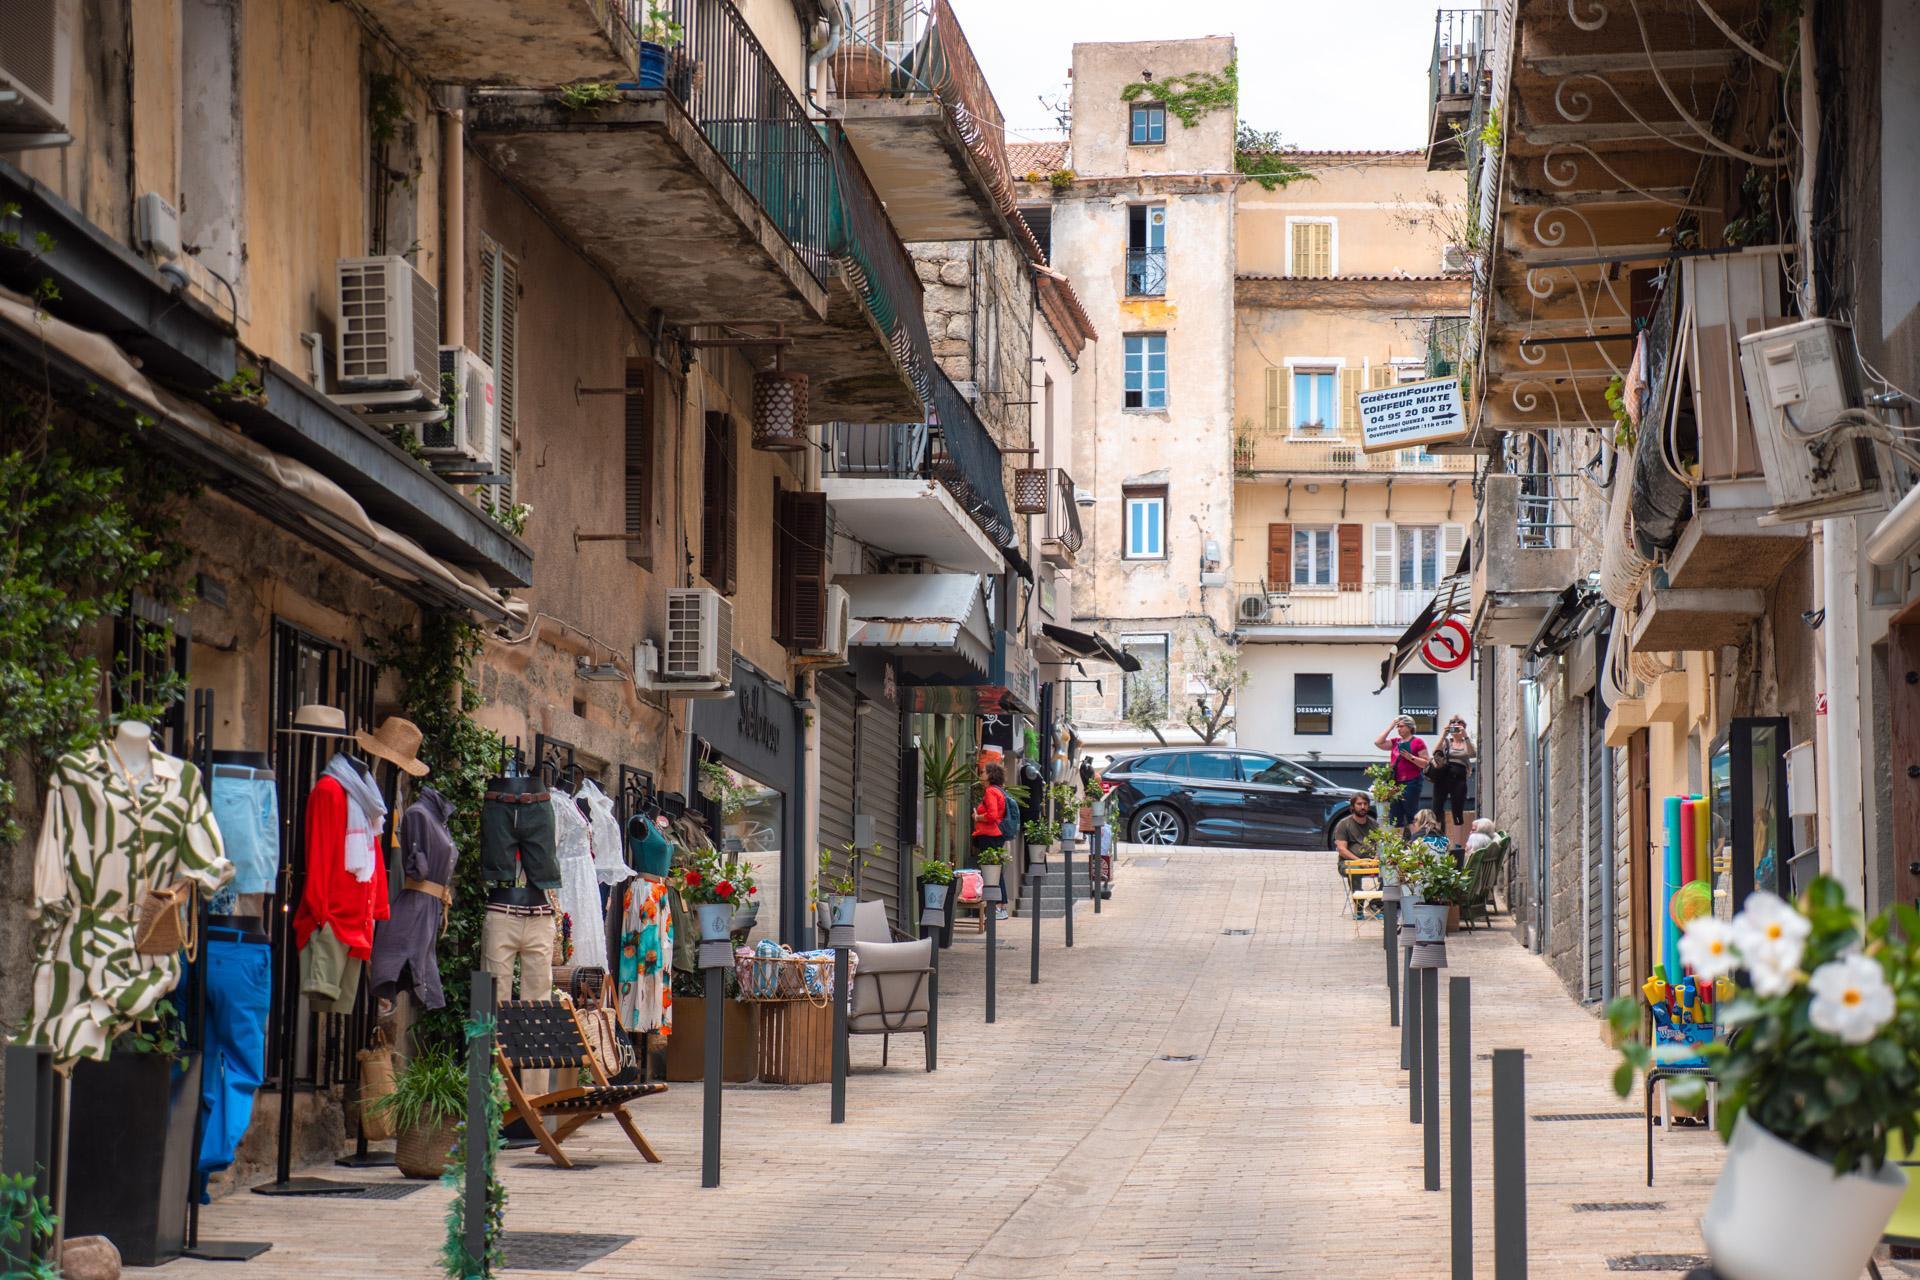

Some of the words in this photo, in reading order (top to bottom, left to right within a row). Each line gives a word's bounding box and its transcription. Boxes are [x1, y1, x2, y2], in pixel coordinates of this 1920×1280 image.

[1363, 399, 1413, 415] COIFFEUR
[1416, 393, 1450, 405] MIXTE
[1370, 416, 1385, 424] 04
[1387, 412, 1401, 421] 95
[1405, 408, 1418, 418] 20
[1421, 405, 1435, 414] 80
[1438, 403, 1452, 412] 87
[1296, 706, 1332, 714] DESSANGE
[1402, 708, 1438, 716] DESSANGE
